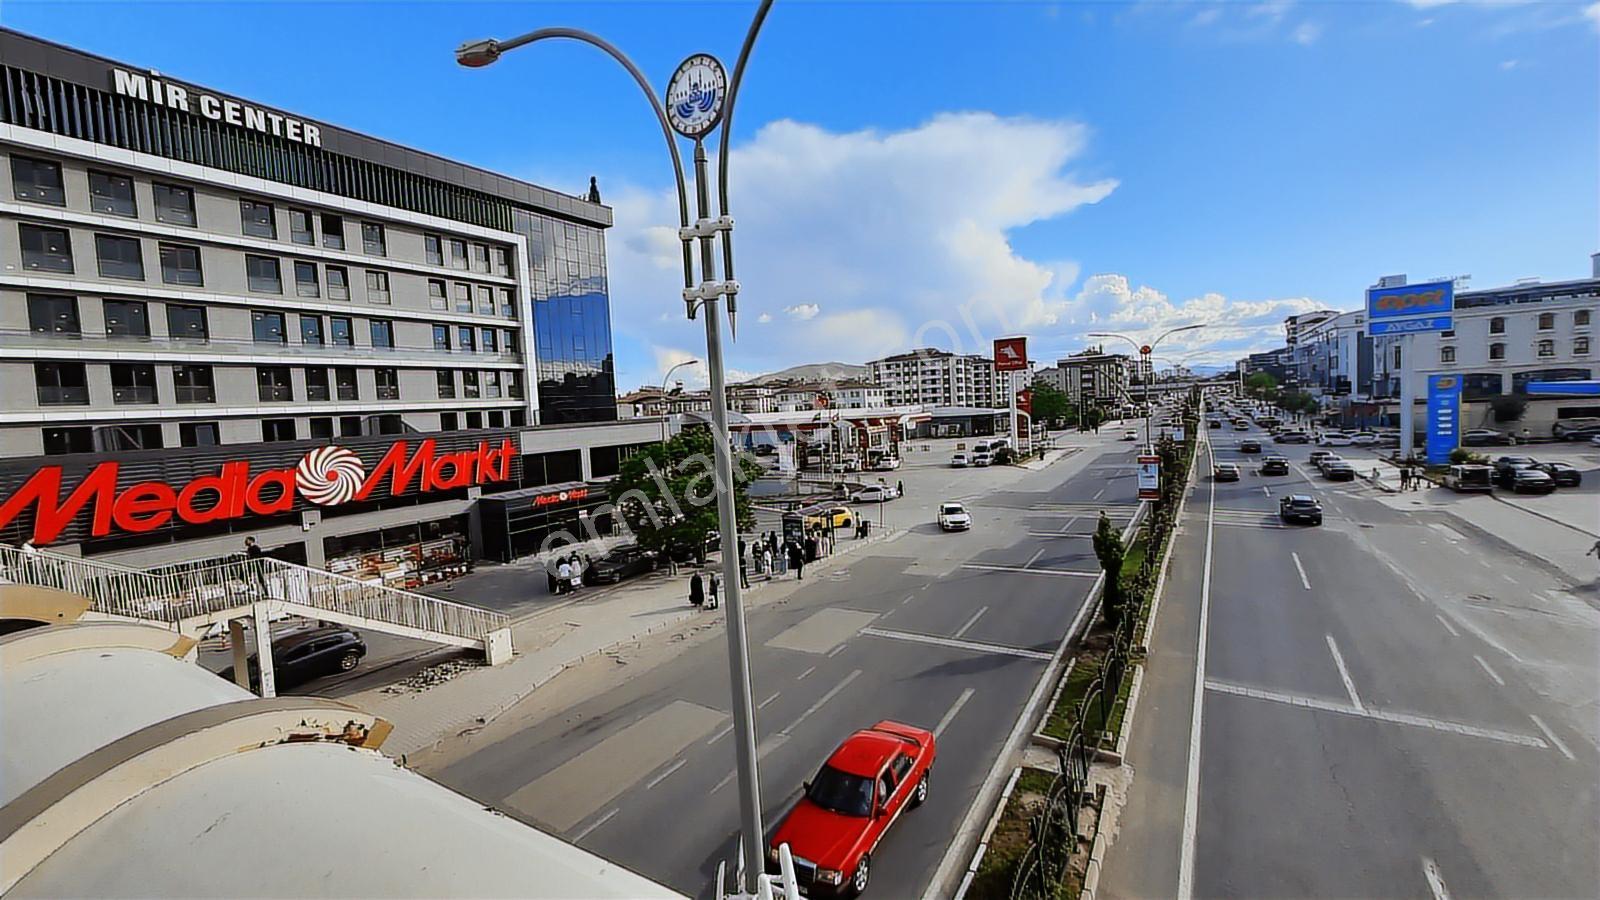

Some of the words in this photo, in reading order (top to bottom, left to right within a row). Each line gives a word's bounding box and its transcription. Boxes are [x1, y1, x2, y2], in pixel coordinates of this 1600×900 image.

[113, 68, 189, 112] MİR
[199, 94, 321, 147] CENTER
[0, 461, 296, 544] Media
[356, 438, 517, 501] Markt
